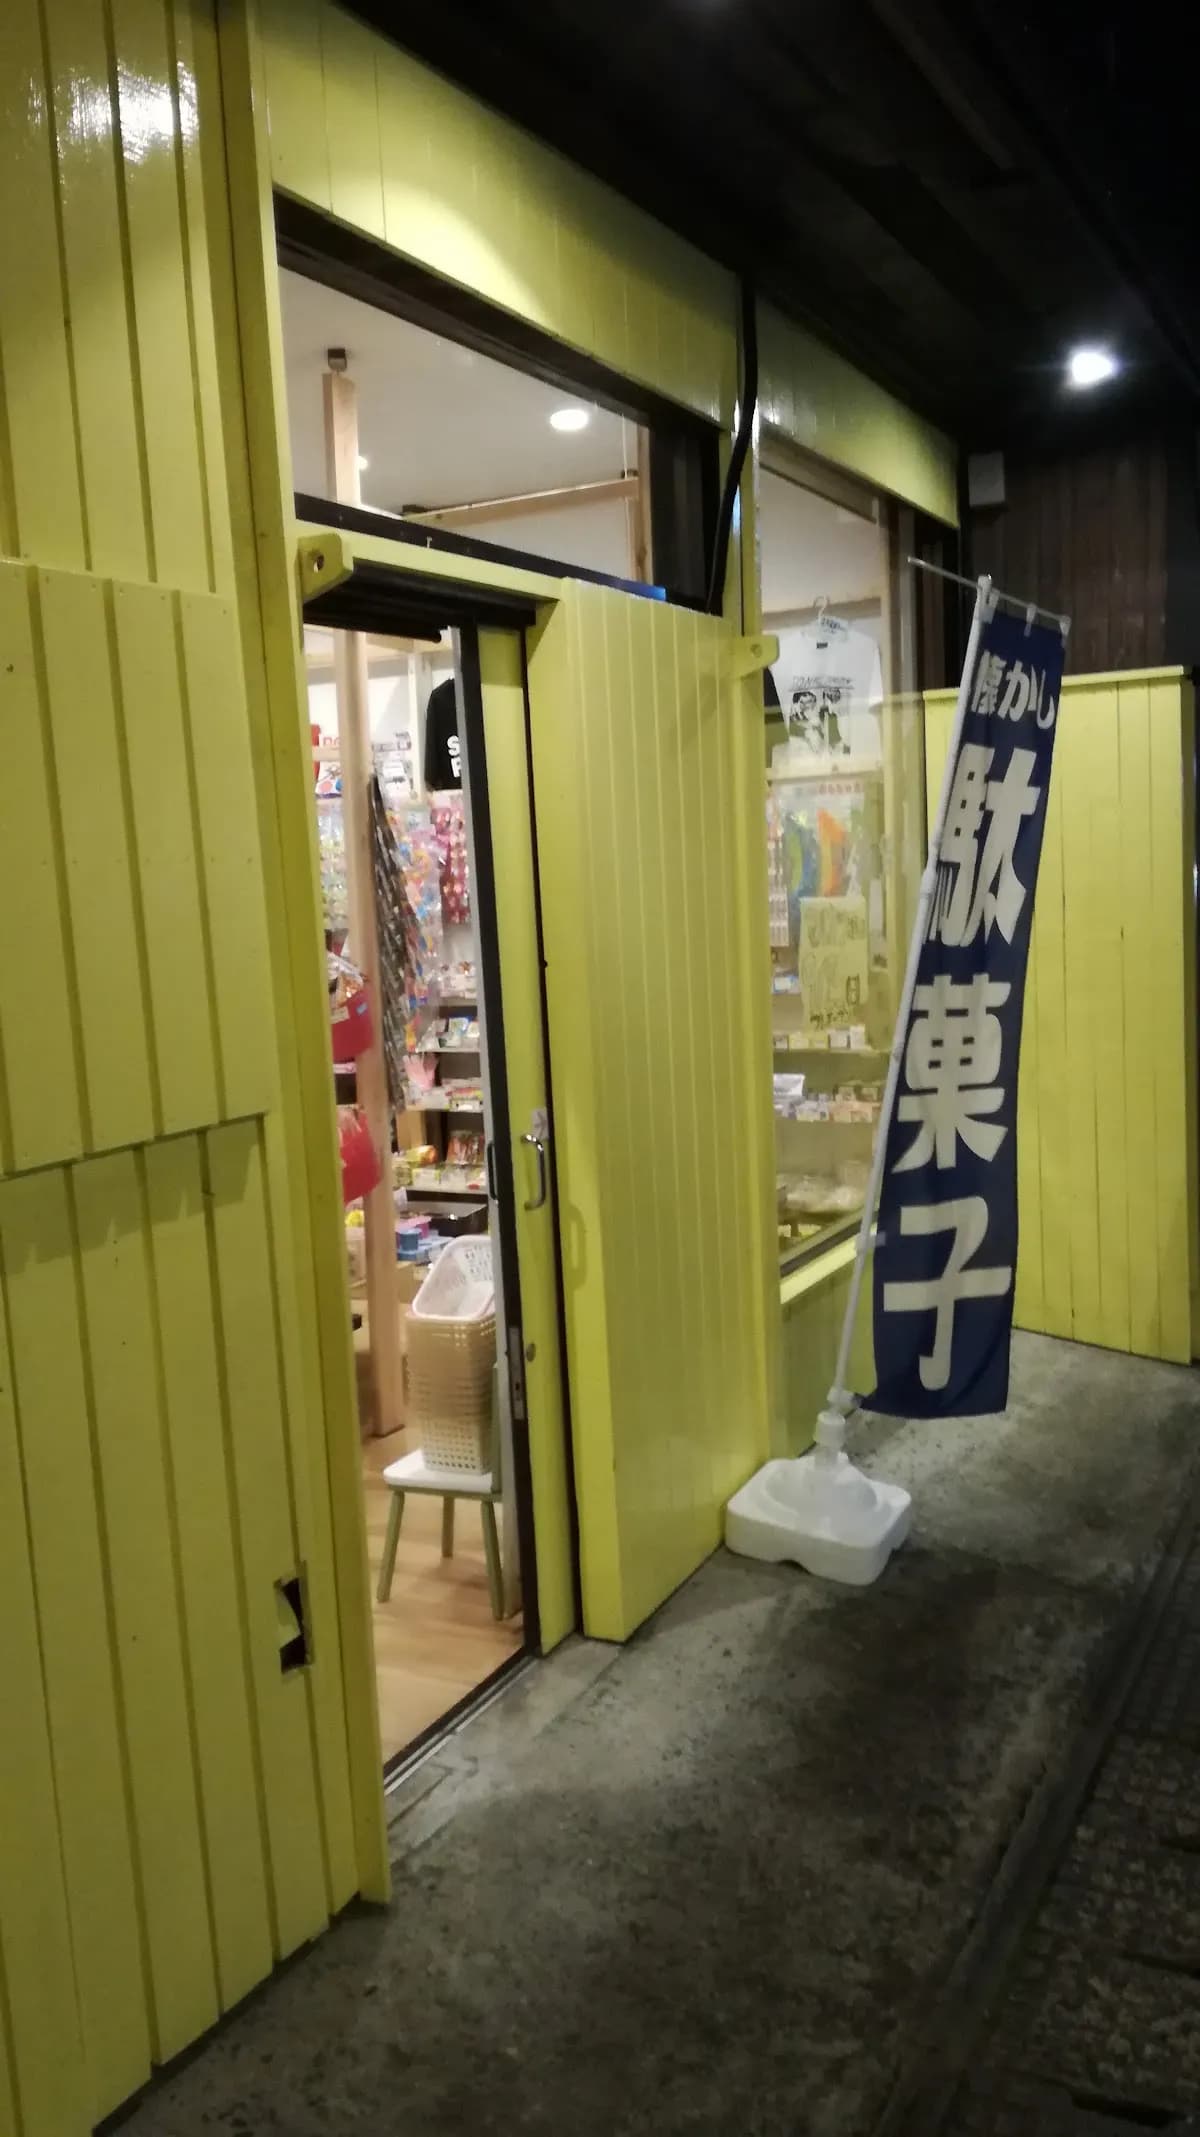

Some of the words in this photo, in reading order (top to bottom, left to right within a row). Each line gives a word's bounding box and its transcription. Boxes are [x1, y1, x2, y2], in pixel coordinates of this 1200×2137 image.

[971, 649, 1055, 729] 懐かし
[884, 743, 1041, 1391] 駄菓子
